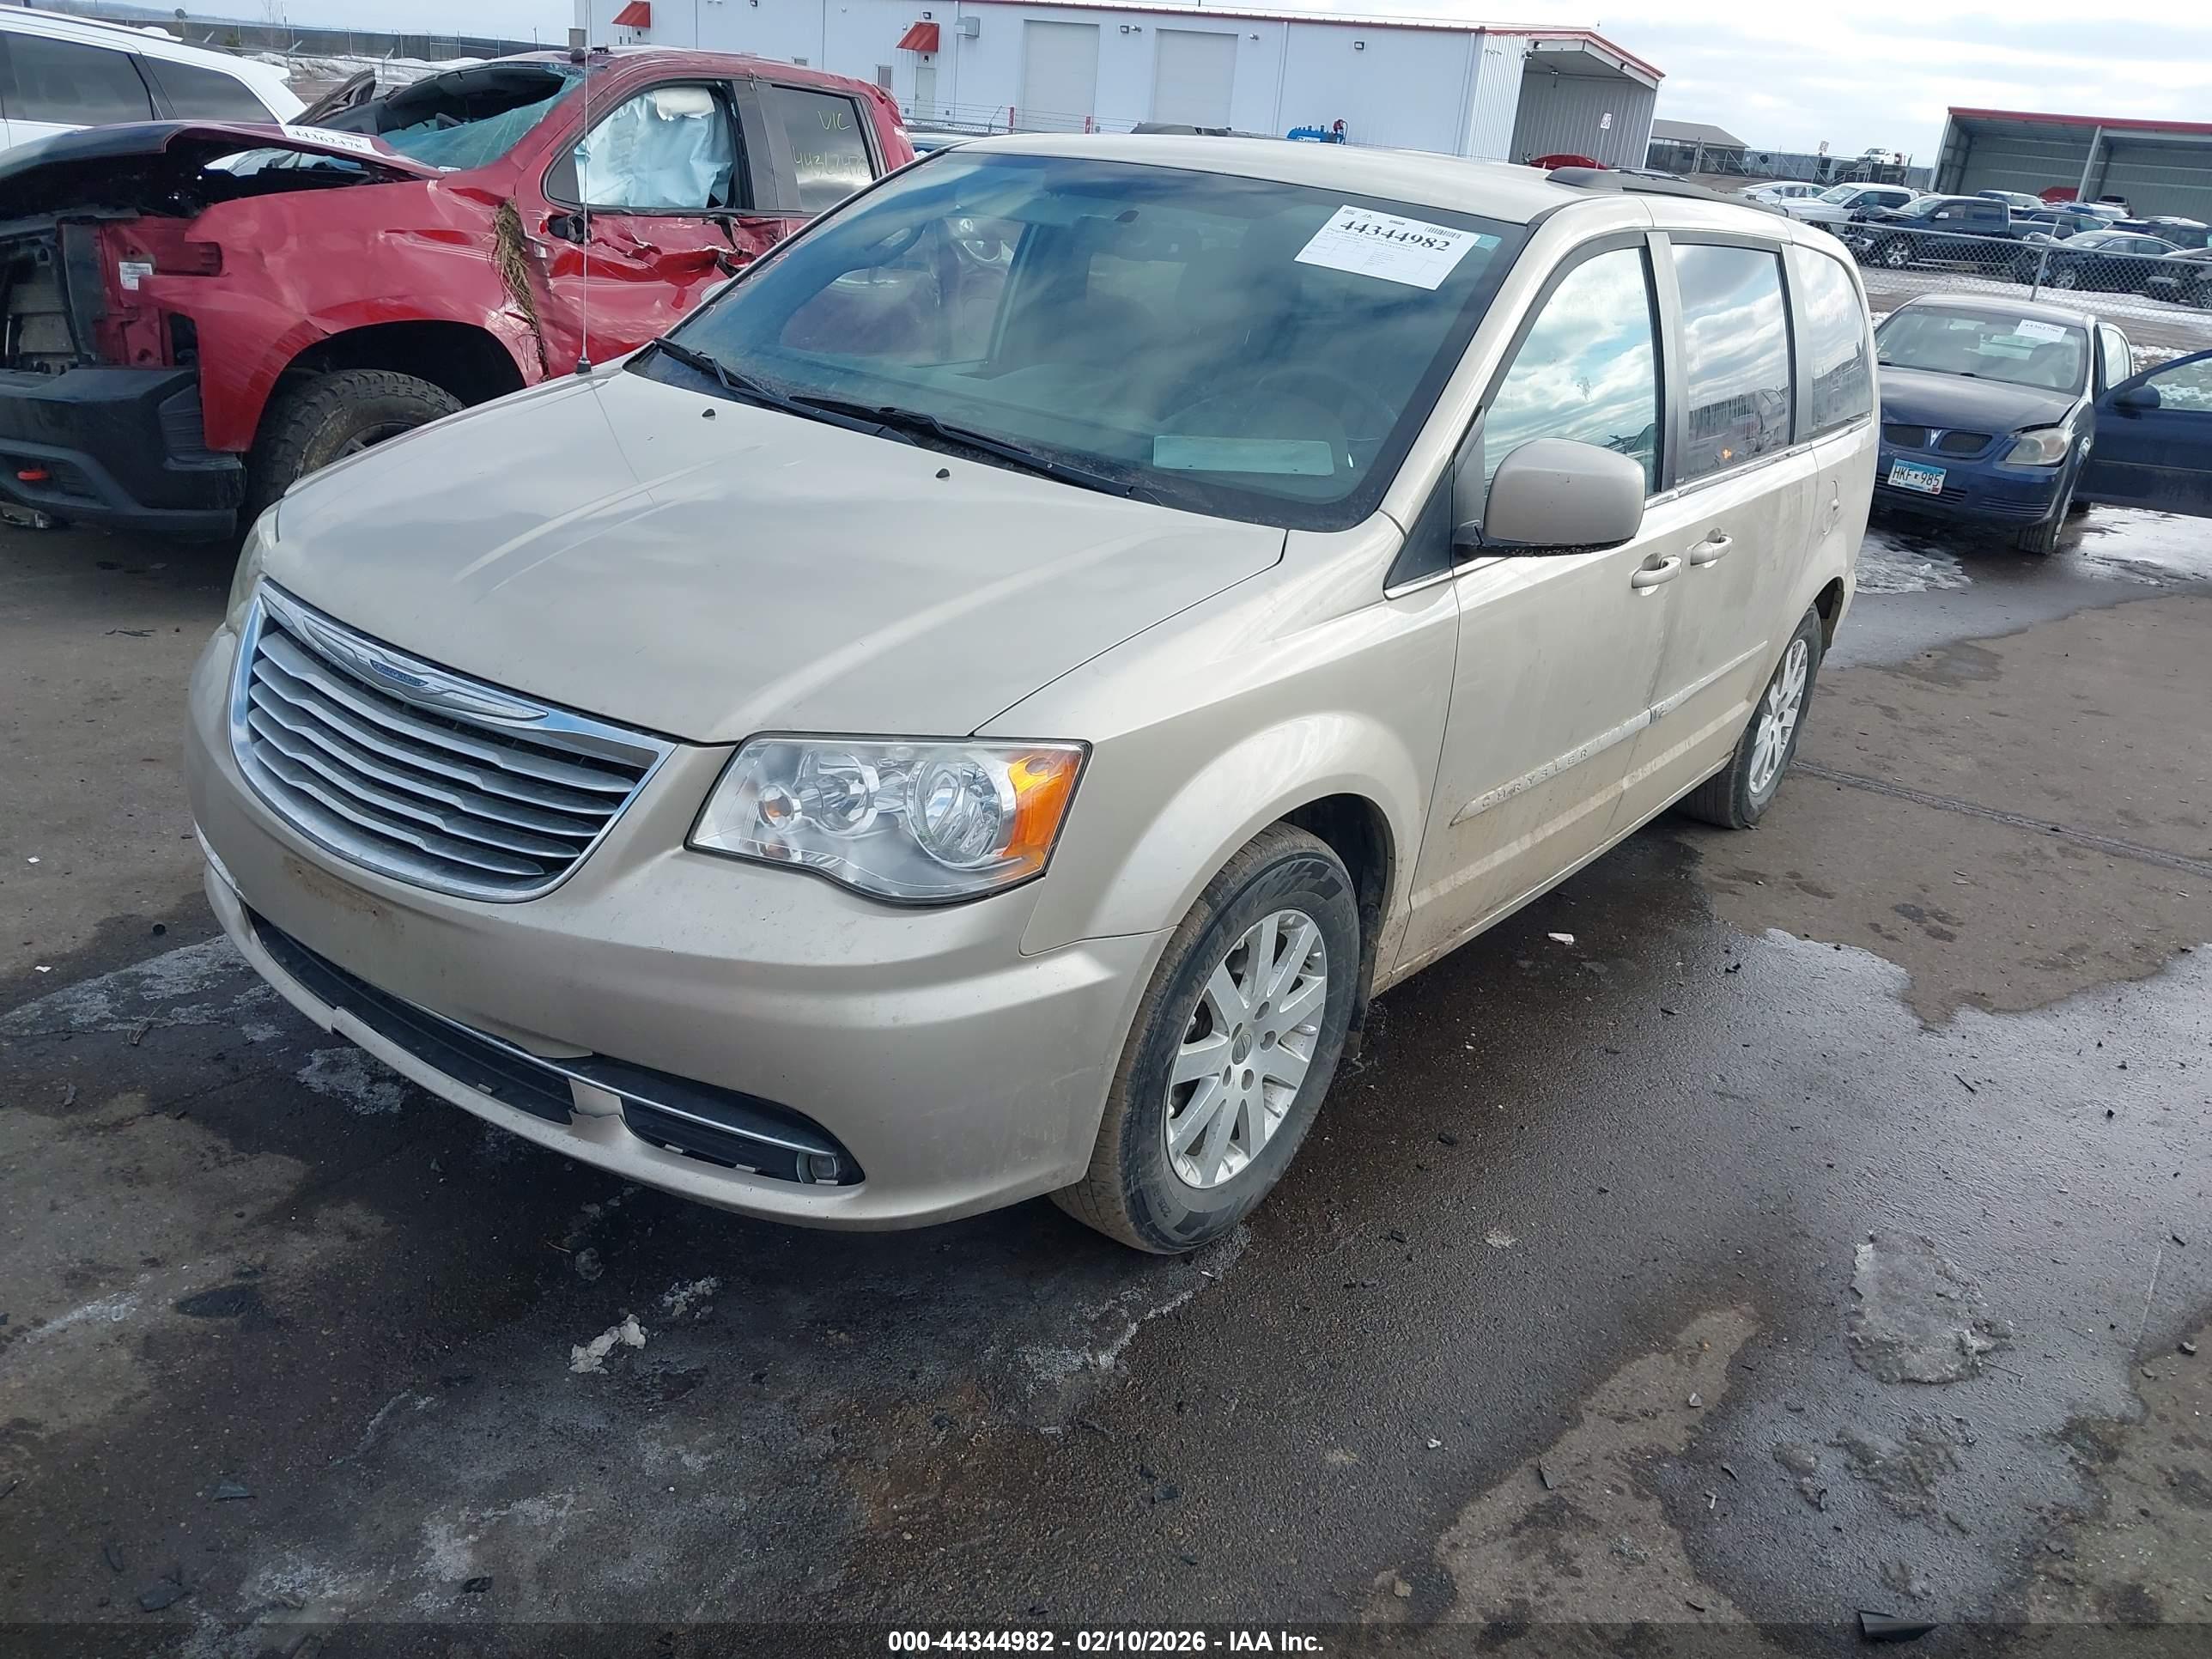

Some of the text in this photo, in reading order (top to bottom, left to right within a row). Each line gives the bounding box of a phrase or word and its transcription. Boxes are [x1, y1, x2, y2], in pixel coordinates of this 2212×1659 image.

[1340, 220, 1451, 252] 44344982
[1892, 466, 1912, 482] HKF
[1920, 471, 1942, 488] 985
[1482, 749, 1588, 808] CHRYSLER
